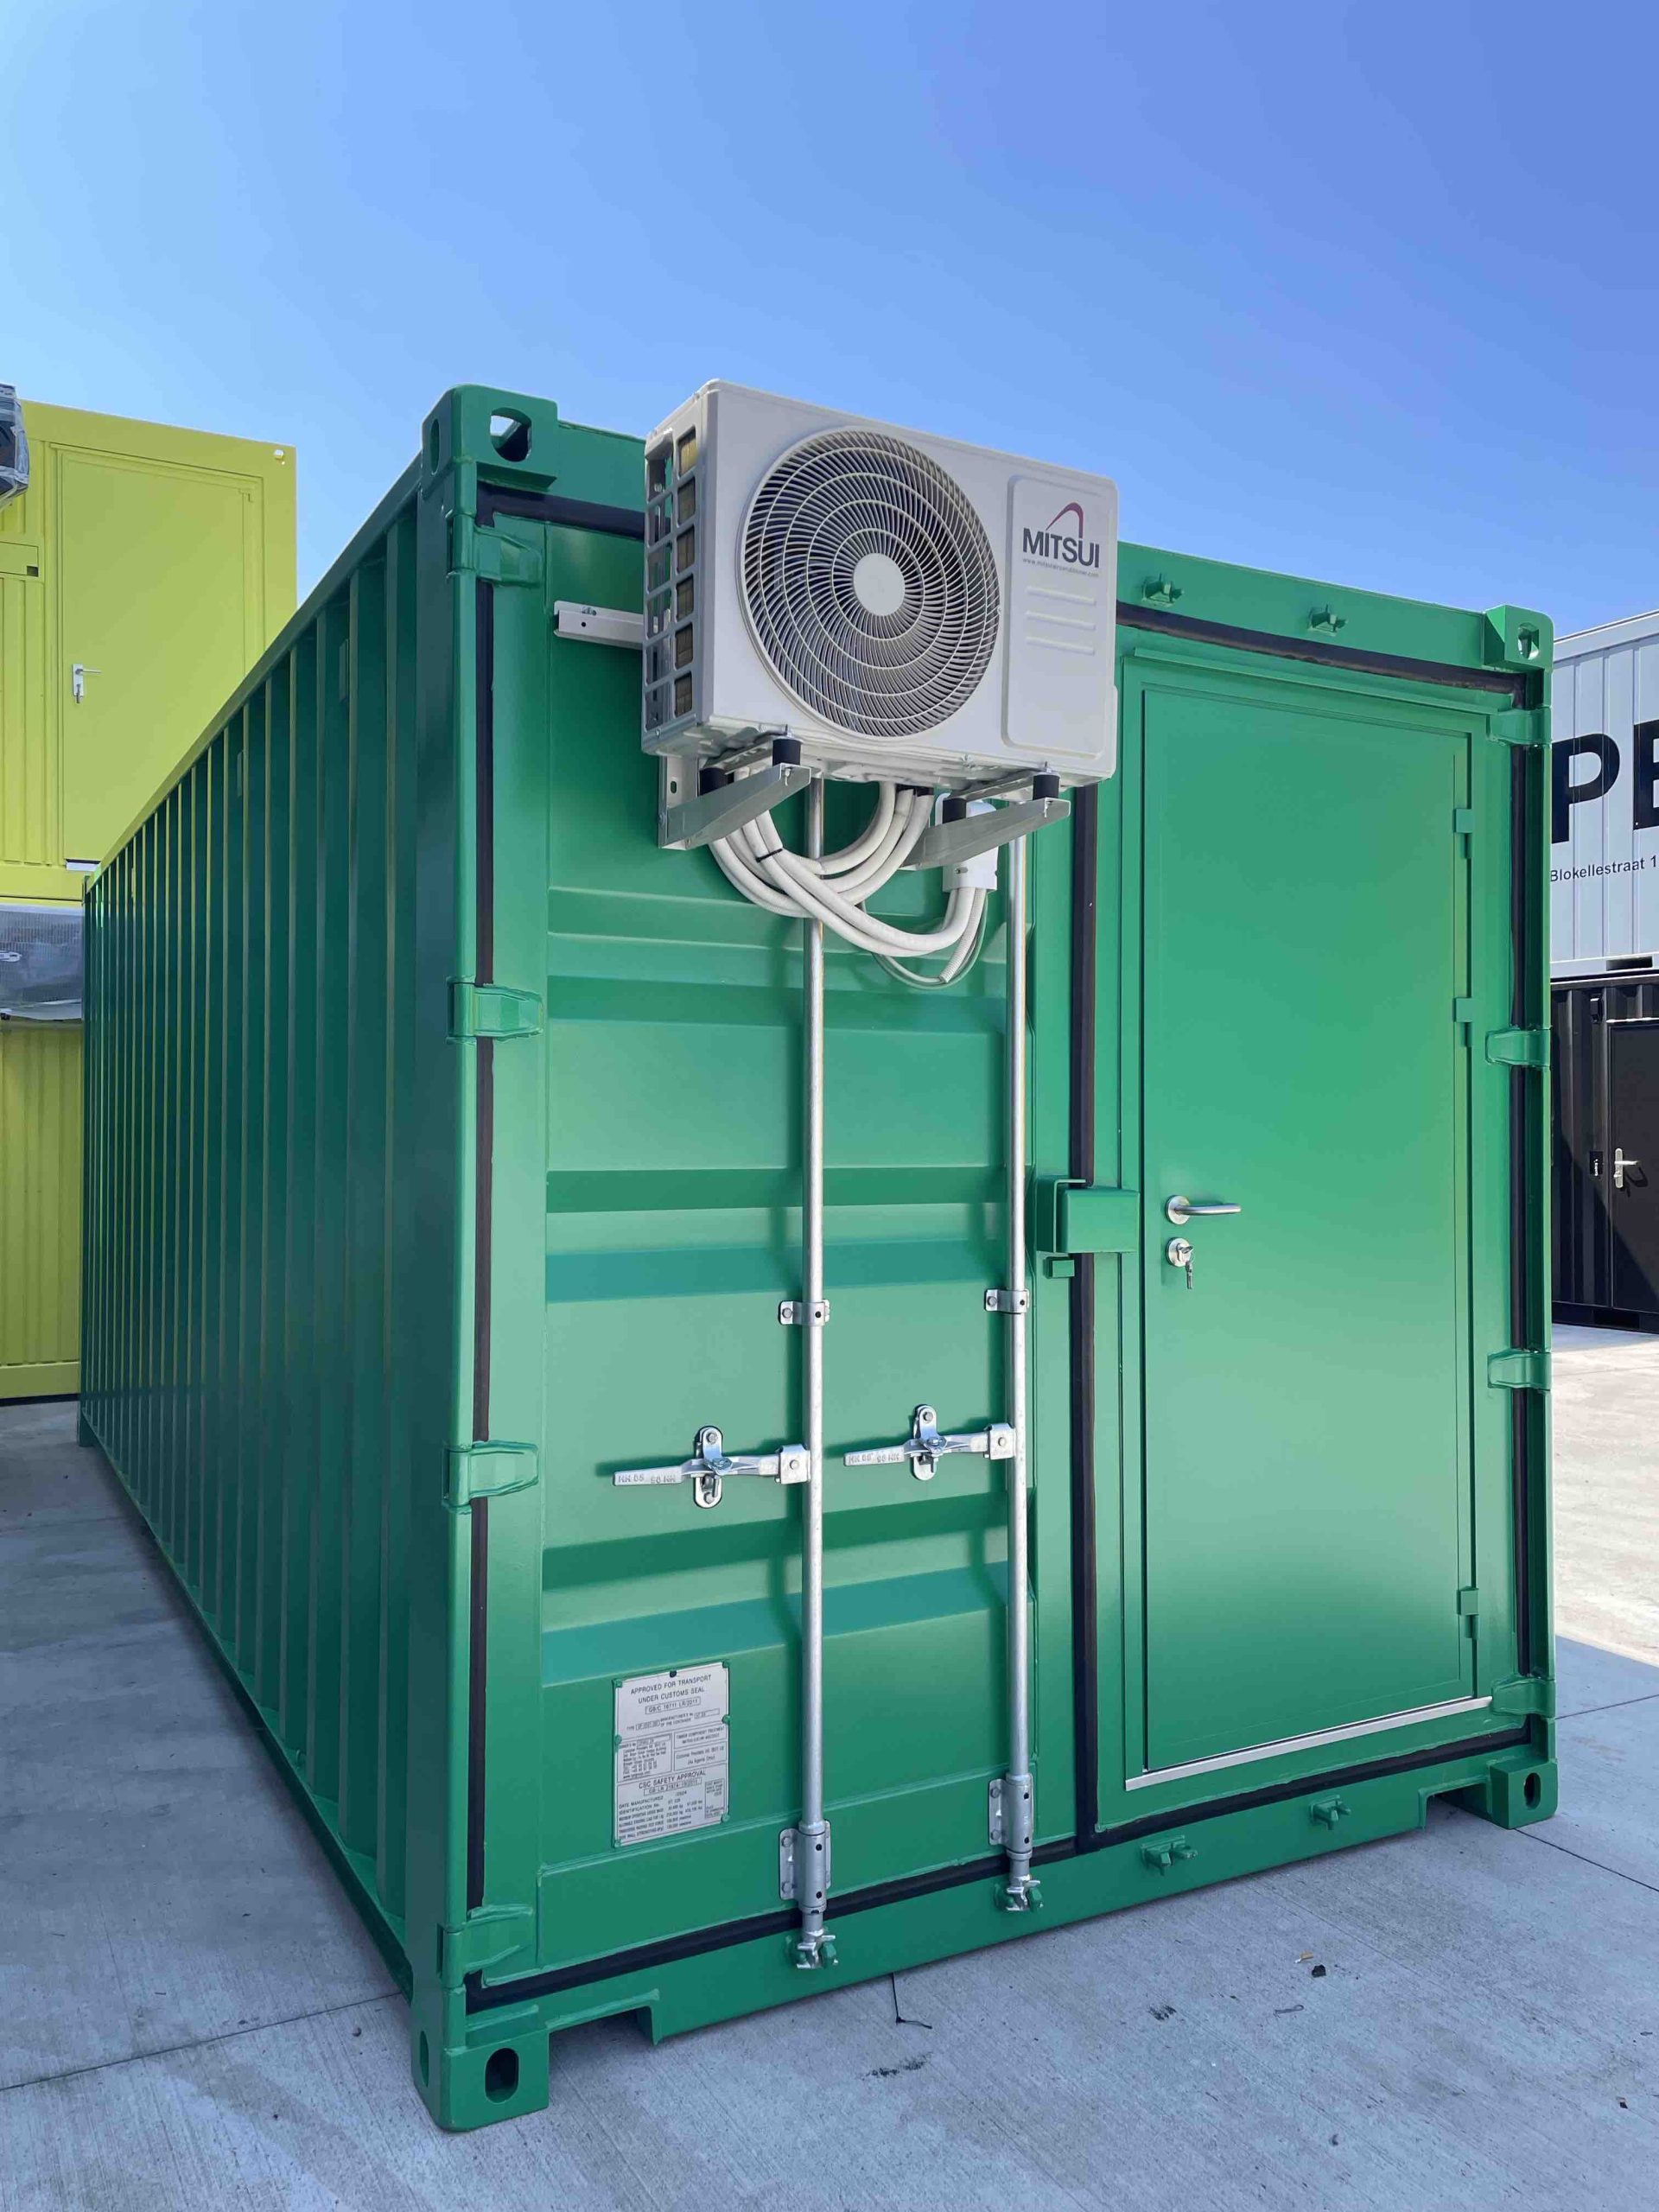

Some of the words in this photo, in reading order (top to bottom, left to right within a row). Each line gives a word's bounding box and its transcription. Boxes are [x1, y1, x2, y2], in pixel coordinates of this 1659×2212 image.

[1022, 527, 1100, 569] MITSUI
[1551, 856, 1645, 882] Blokellestraat
[631, 1683, 662, 1694] APPROVED
[678, 1675, 711, 1686] TRANSPORT
[639, 1694, 658, 1704] UNDER
[661, 1689, 689, 1700] CUSTOMS
[653, 1777, 674, 1785] SAFETY
[677, 1770, 706, 1780] APPROVAL
